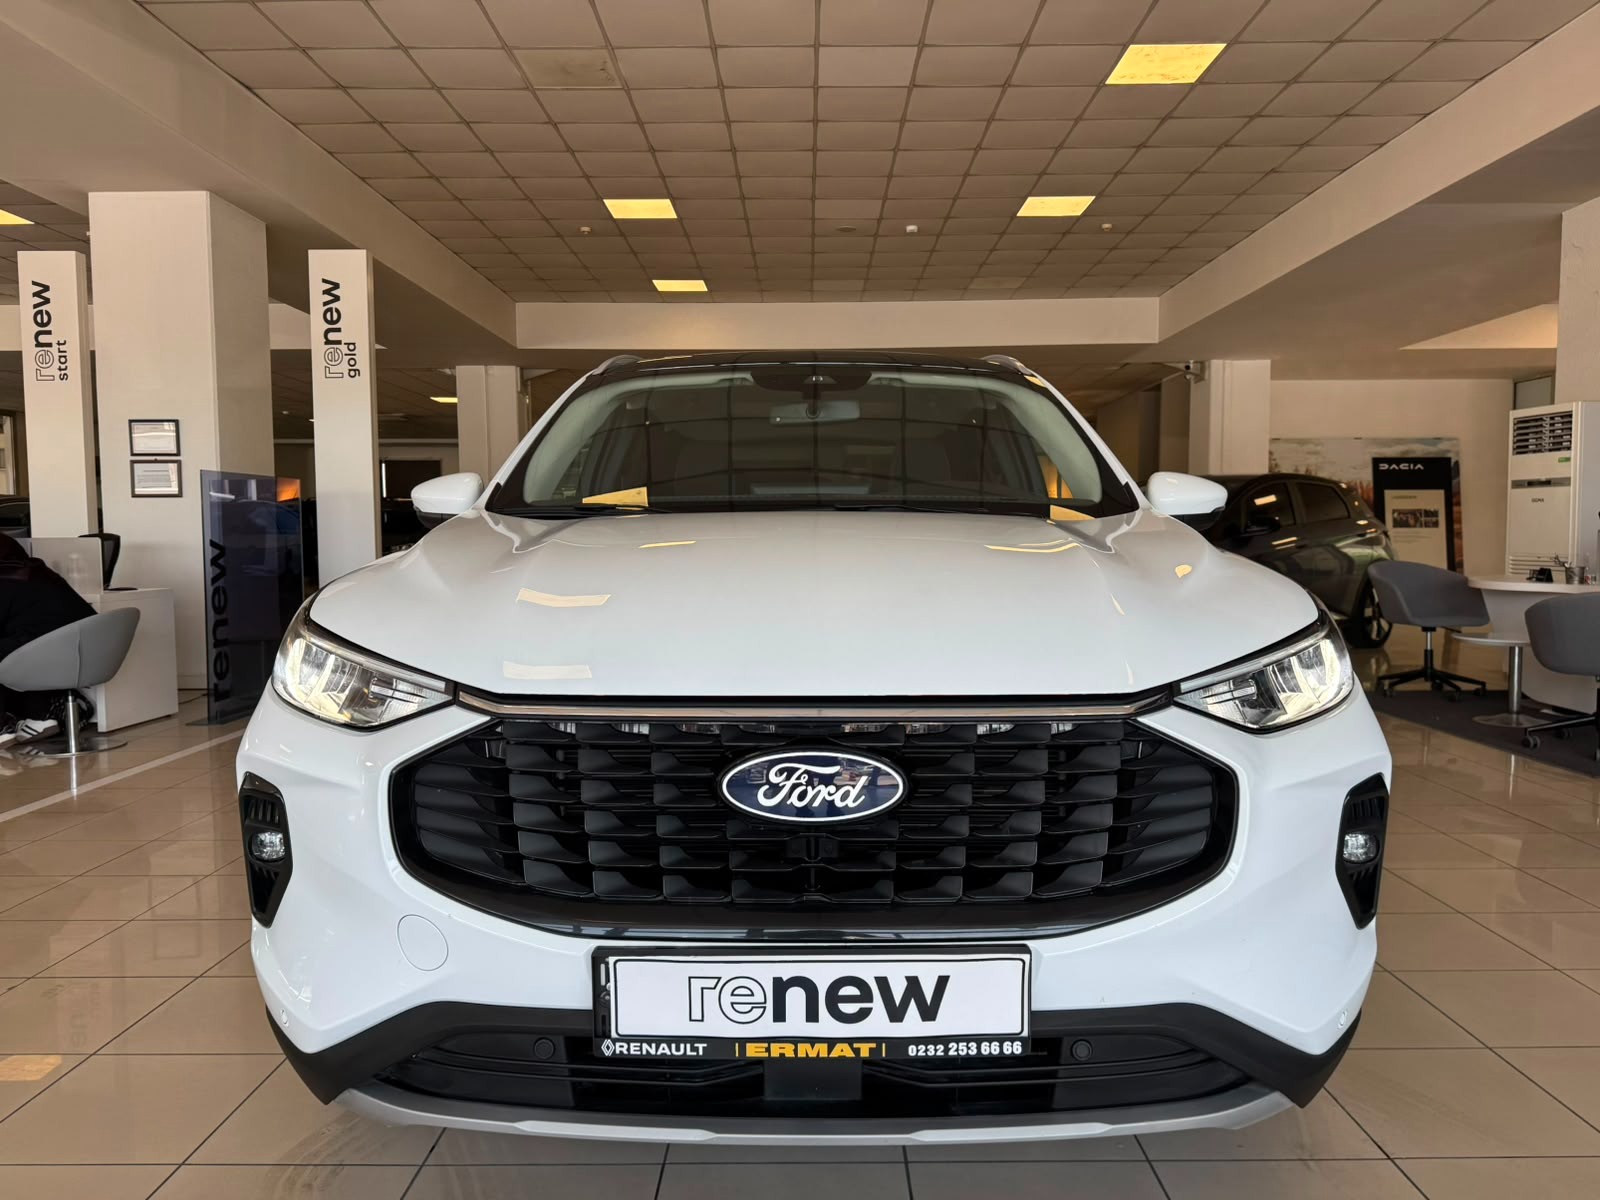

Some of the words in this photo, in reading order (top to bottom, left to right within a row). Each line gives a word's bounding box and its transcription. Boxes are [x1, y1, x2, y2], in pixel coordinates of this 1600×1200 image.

[31, 280, 55, 381] renew
[321, 278, 344, 379] renew
[56, 339, 69, 381] start
[343, 342, 361, 378] gold
[209, 538, 232, 702] renew
[757, 762, 868, 808] Ford
[688, 975, 950, 1025] renew
[615, 1042, 708, 1056] RENAULT
[745, 1042, 877, 1058] ERMAT
[908, 1044, 944, 1056] 0232
[948, 1042, 977, 1056] 253
[980, 1041, 1000, 1055] 66
[1002, 1041, 1022, 1055] 66
